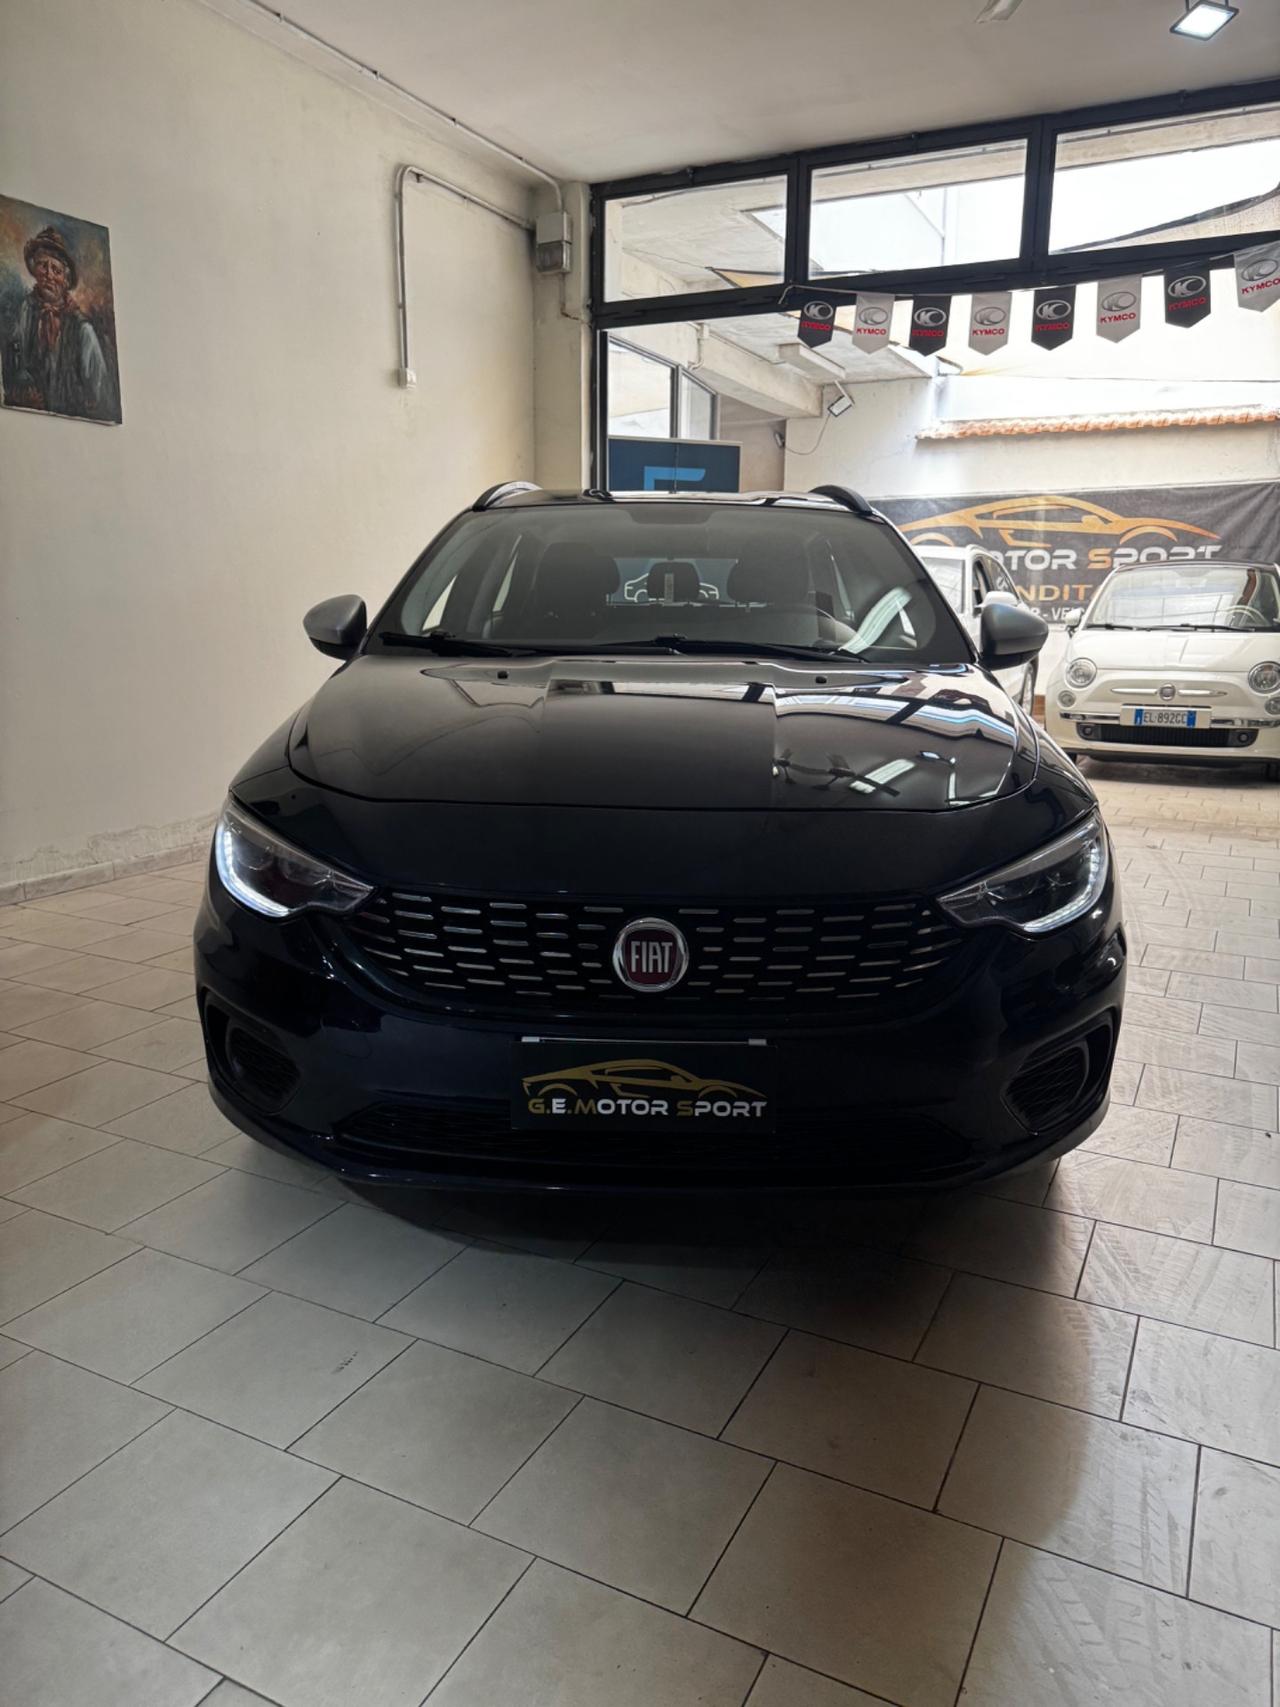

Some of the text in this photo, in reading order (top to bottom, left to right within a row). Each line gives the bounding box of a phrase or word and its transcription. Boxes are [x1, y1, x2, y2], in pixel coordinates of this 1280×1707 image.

[1241, 278, 1280, 295] KYMCO
[1100, 312, 1136, 323] KYMCO
[856, 327, 886, 336] KYMCO
[972, 328, 1005, 336] KYMCO
[631, 940, 673, 973] FIAT
[676, 1100, 767, 1117] SPORT
